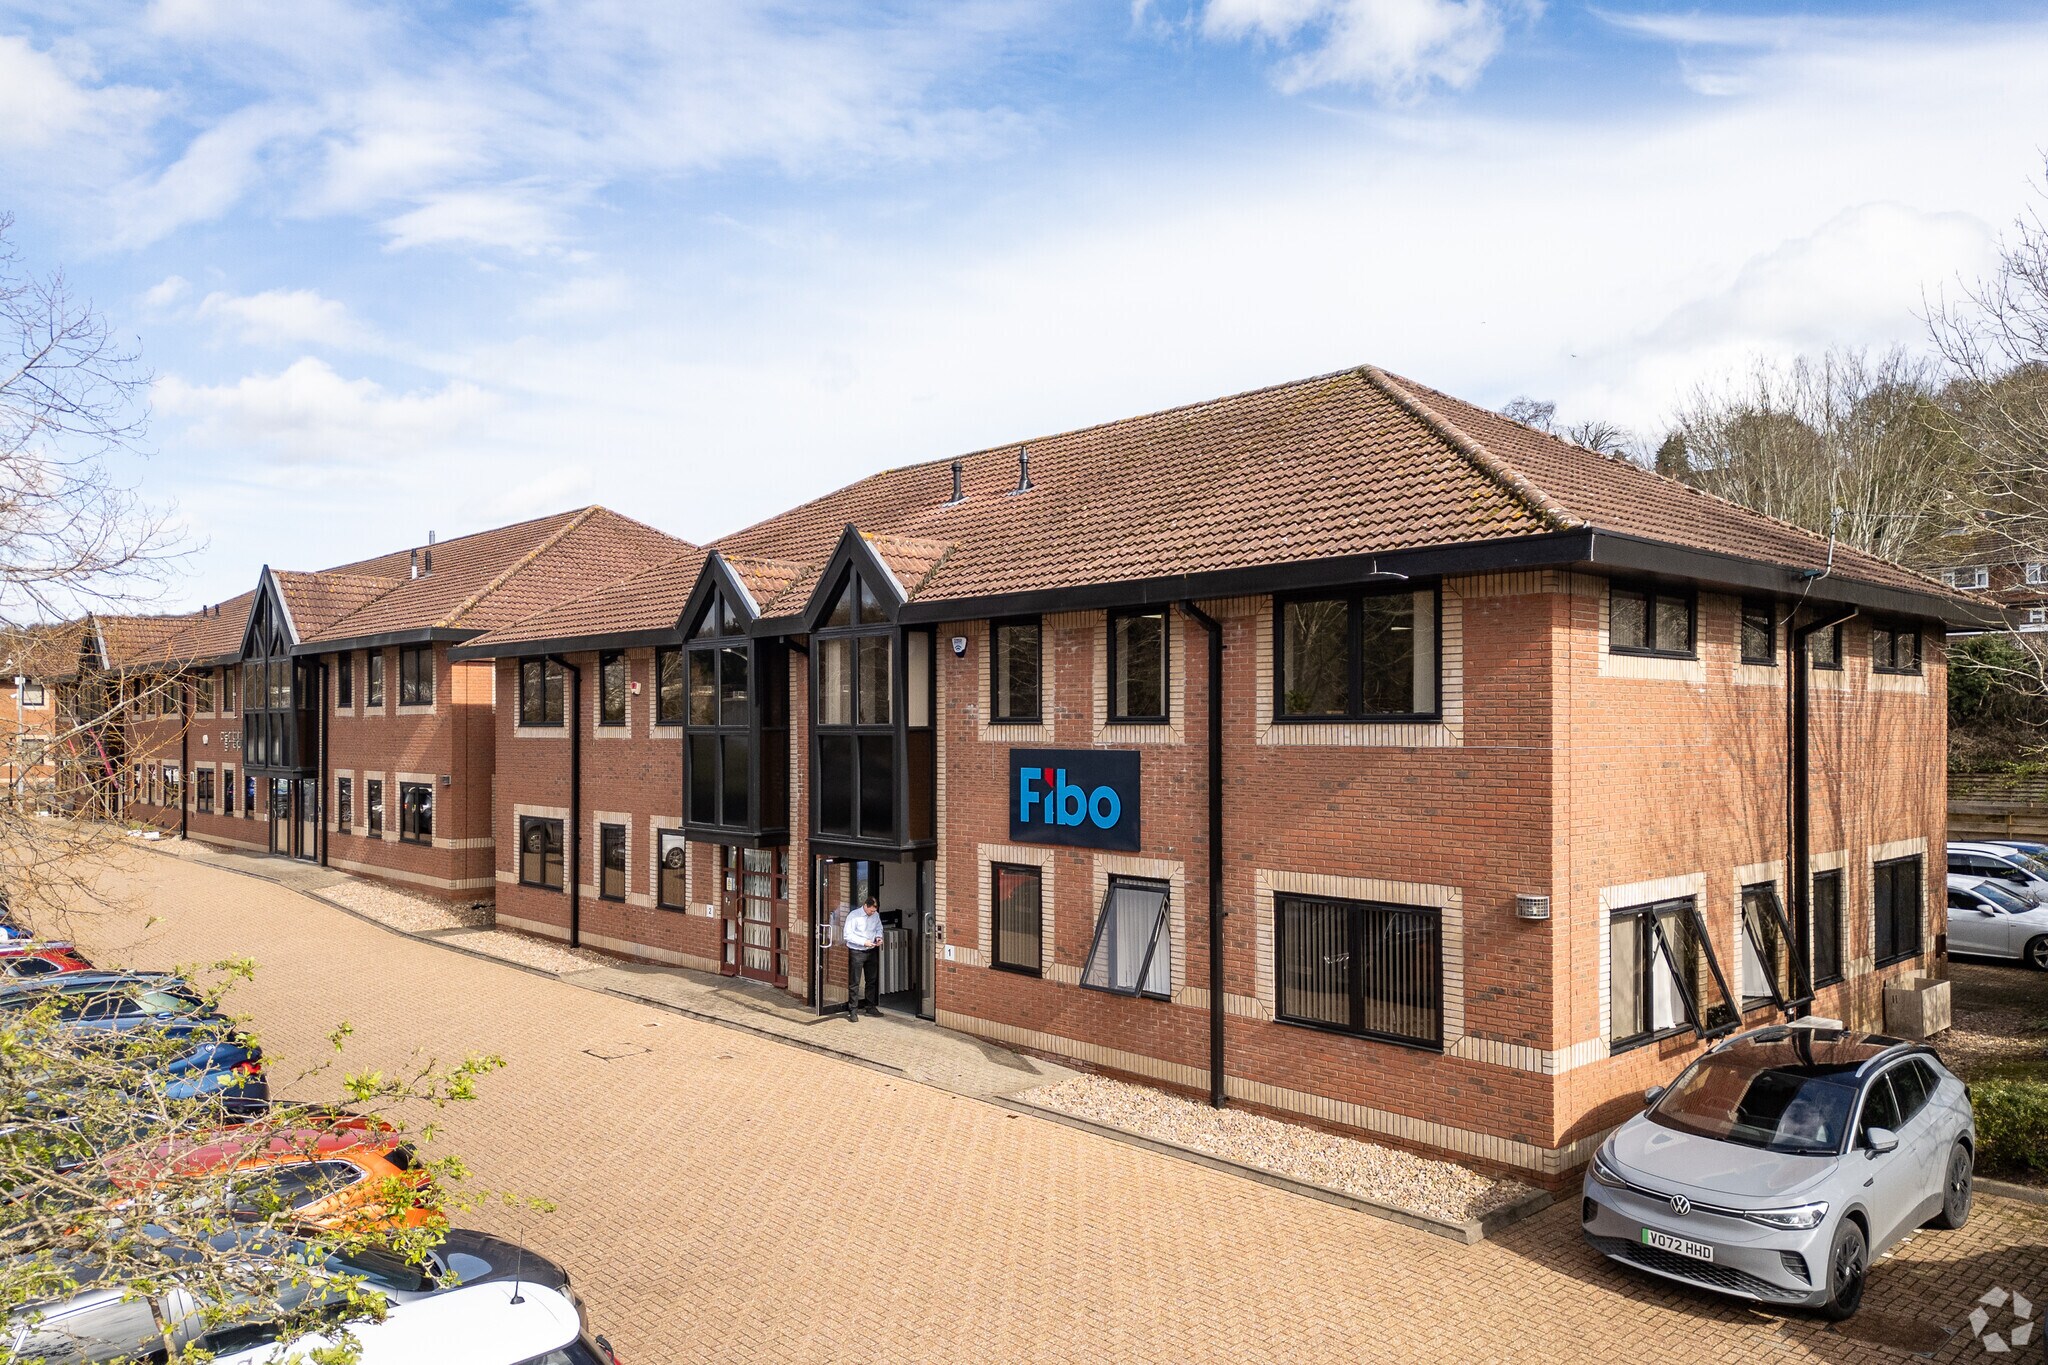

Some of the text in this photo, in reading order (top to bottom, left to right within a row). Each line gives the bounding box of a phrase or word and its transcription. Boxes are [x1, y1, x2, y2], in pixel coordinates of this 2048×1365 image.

[1020, 767, 1121, 829] Fibo
[1650, 1231, 1711, 1259] VO72 HHD
